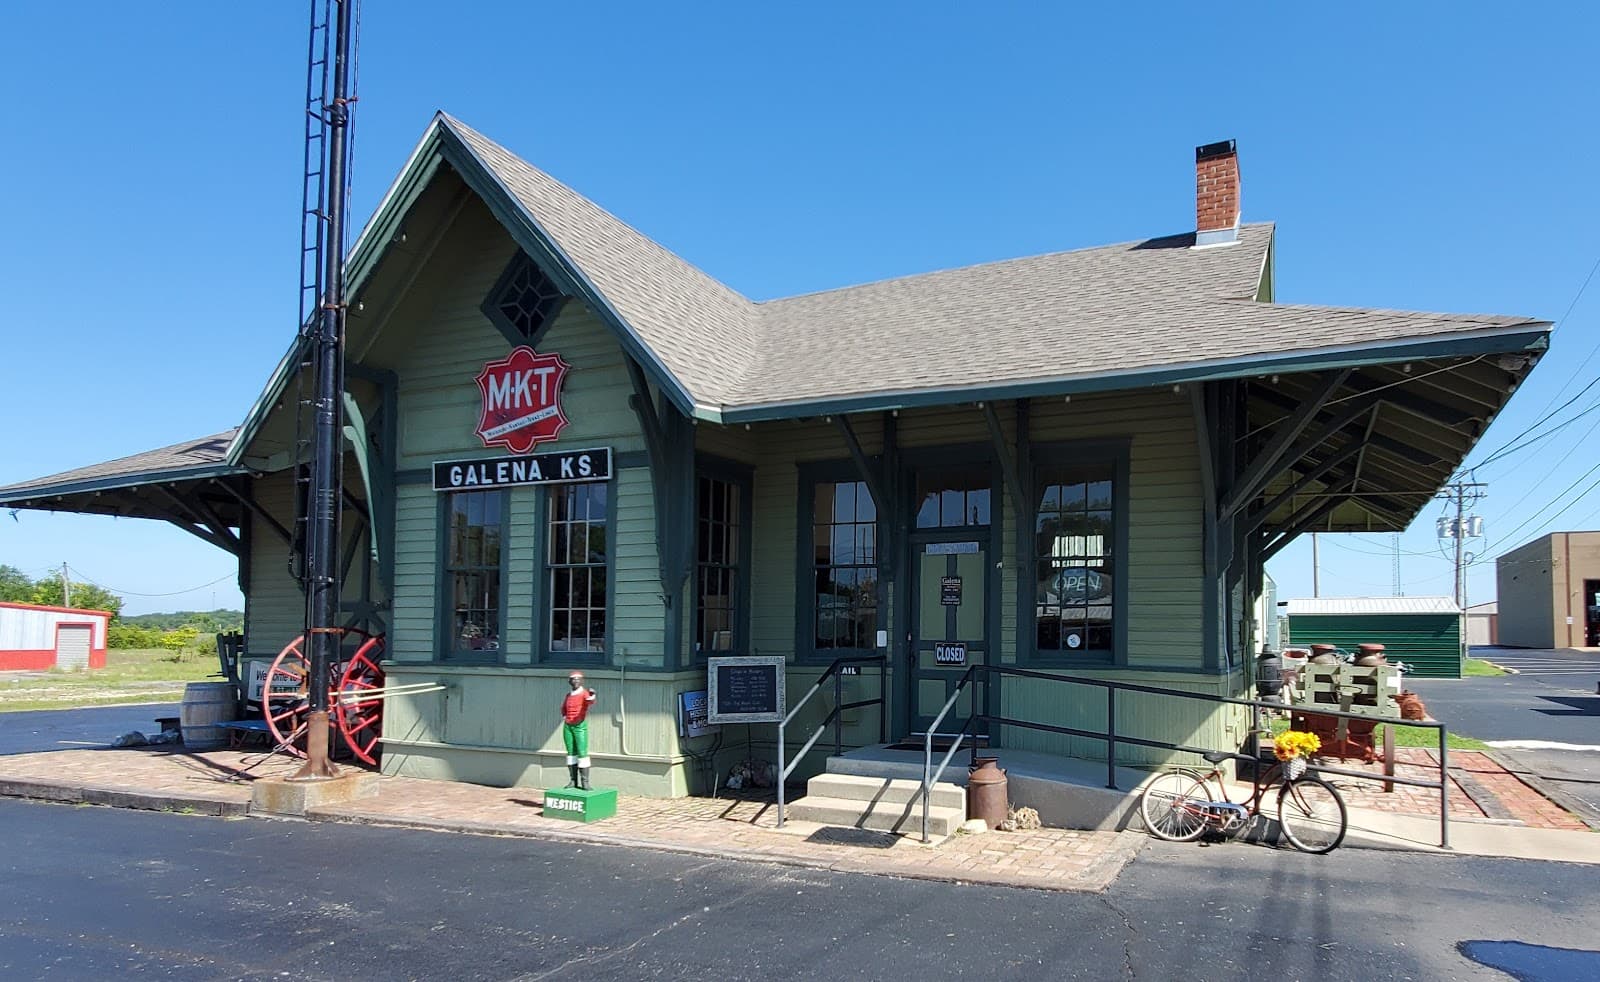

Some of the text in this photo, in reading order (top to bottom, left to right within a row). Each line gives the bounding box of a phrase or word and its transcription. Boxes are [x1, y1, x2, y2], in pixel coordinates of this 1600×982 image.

[1054, 575, 1101, 592] OPEN
[936, 646, 964, 662] CLOSED
[256, 670, 288, 681] Weome
